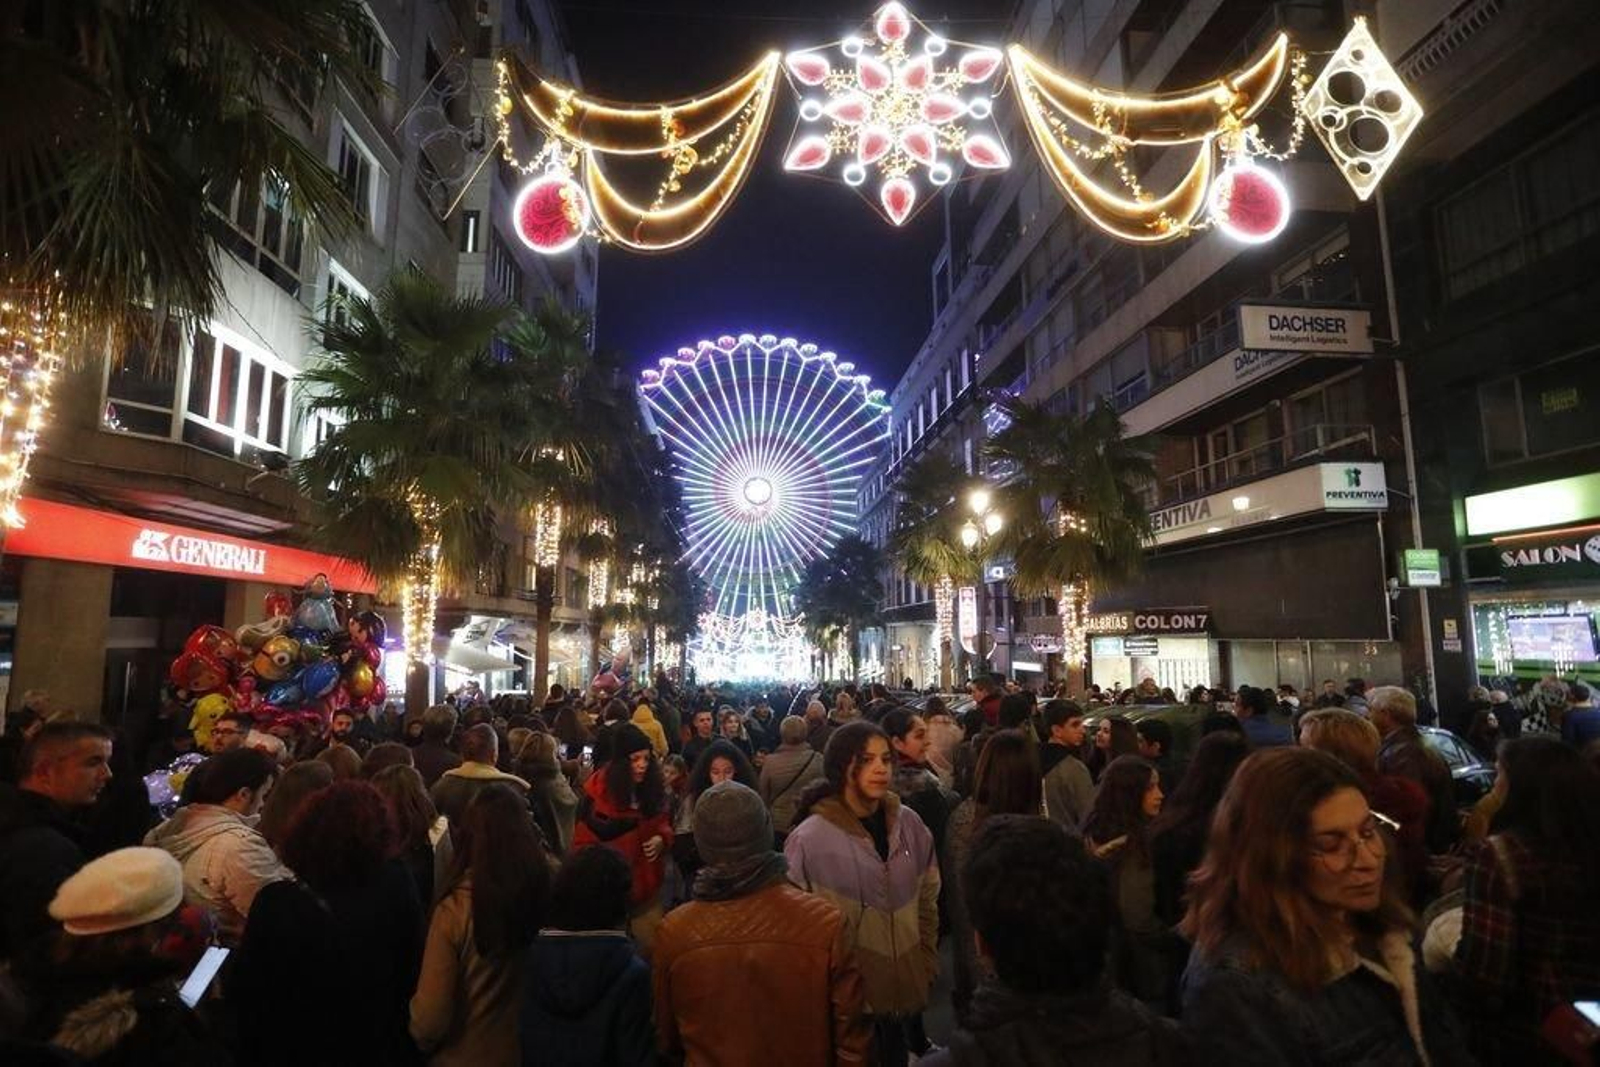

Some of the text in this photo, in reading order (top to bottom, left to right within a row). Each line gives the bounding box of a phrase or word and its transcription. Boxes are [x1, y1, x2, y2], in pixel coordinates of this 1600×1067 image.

[1268, 314, 1346, 333] DACHSER
[1269, 333, 1310, 345] Intelligent
[1325, 490, 1386, 500] PREVENTIVA
[1149, 498, 1212, 531] ENTIVA
[170, 534, 266, 575] GENERALI
[1501, 544, 1582, 568] SALON
